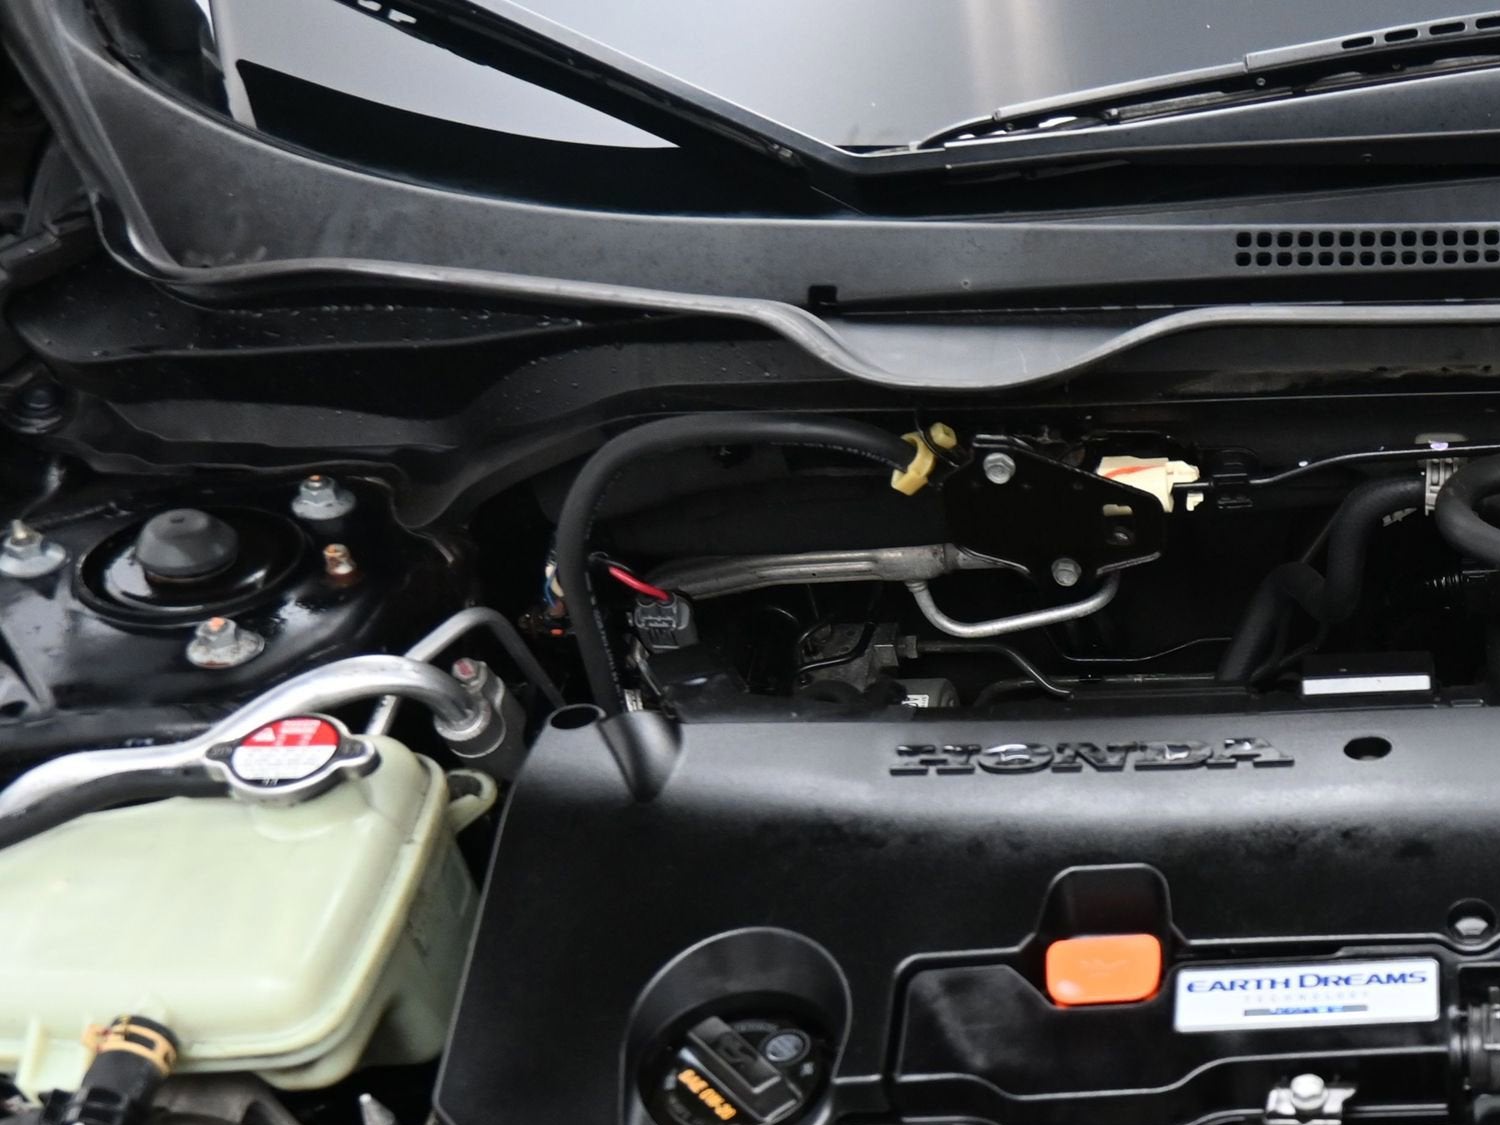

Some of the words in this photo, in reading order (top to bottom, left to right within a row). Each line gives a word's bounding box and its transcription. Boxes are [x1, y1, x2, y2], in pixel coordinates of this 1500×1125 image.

[889, 737, 1295, 776] HONDA
[1187, 977, 1290, 993] EARTH
[1299, 971, 1427, 989] DREAMS
